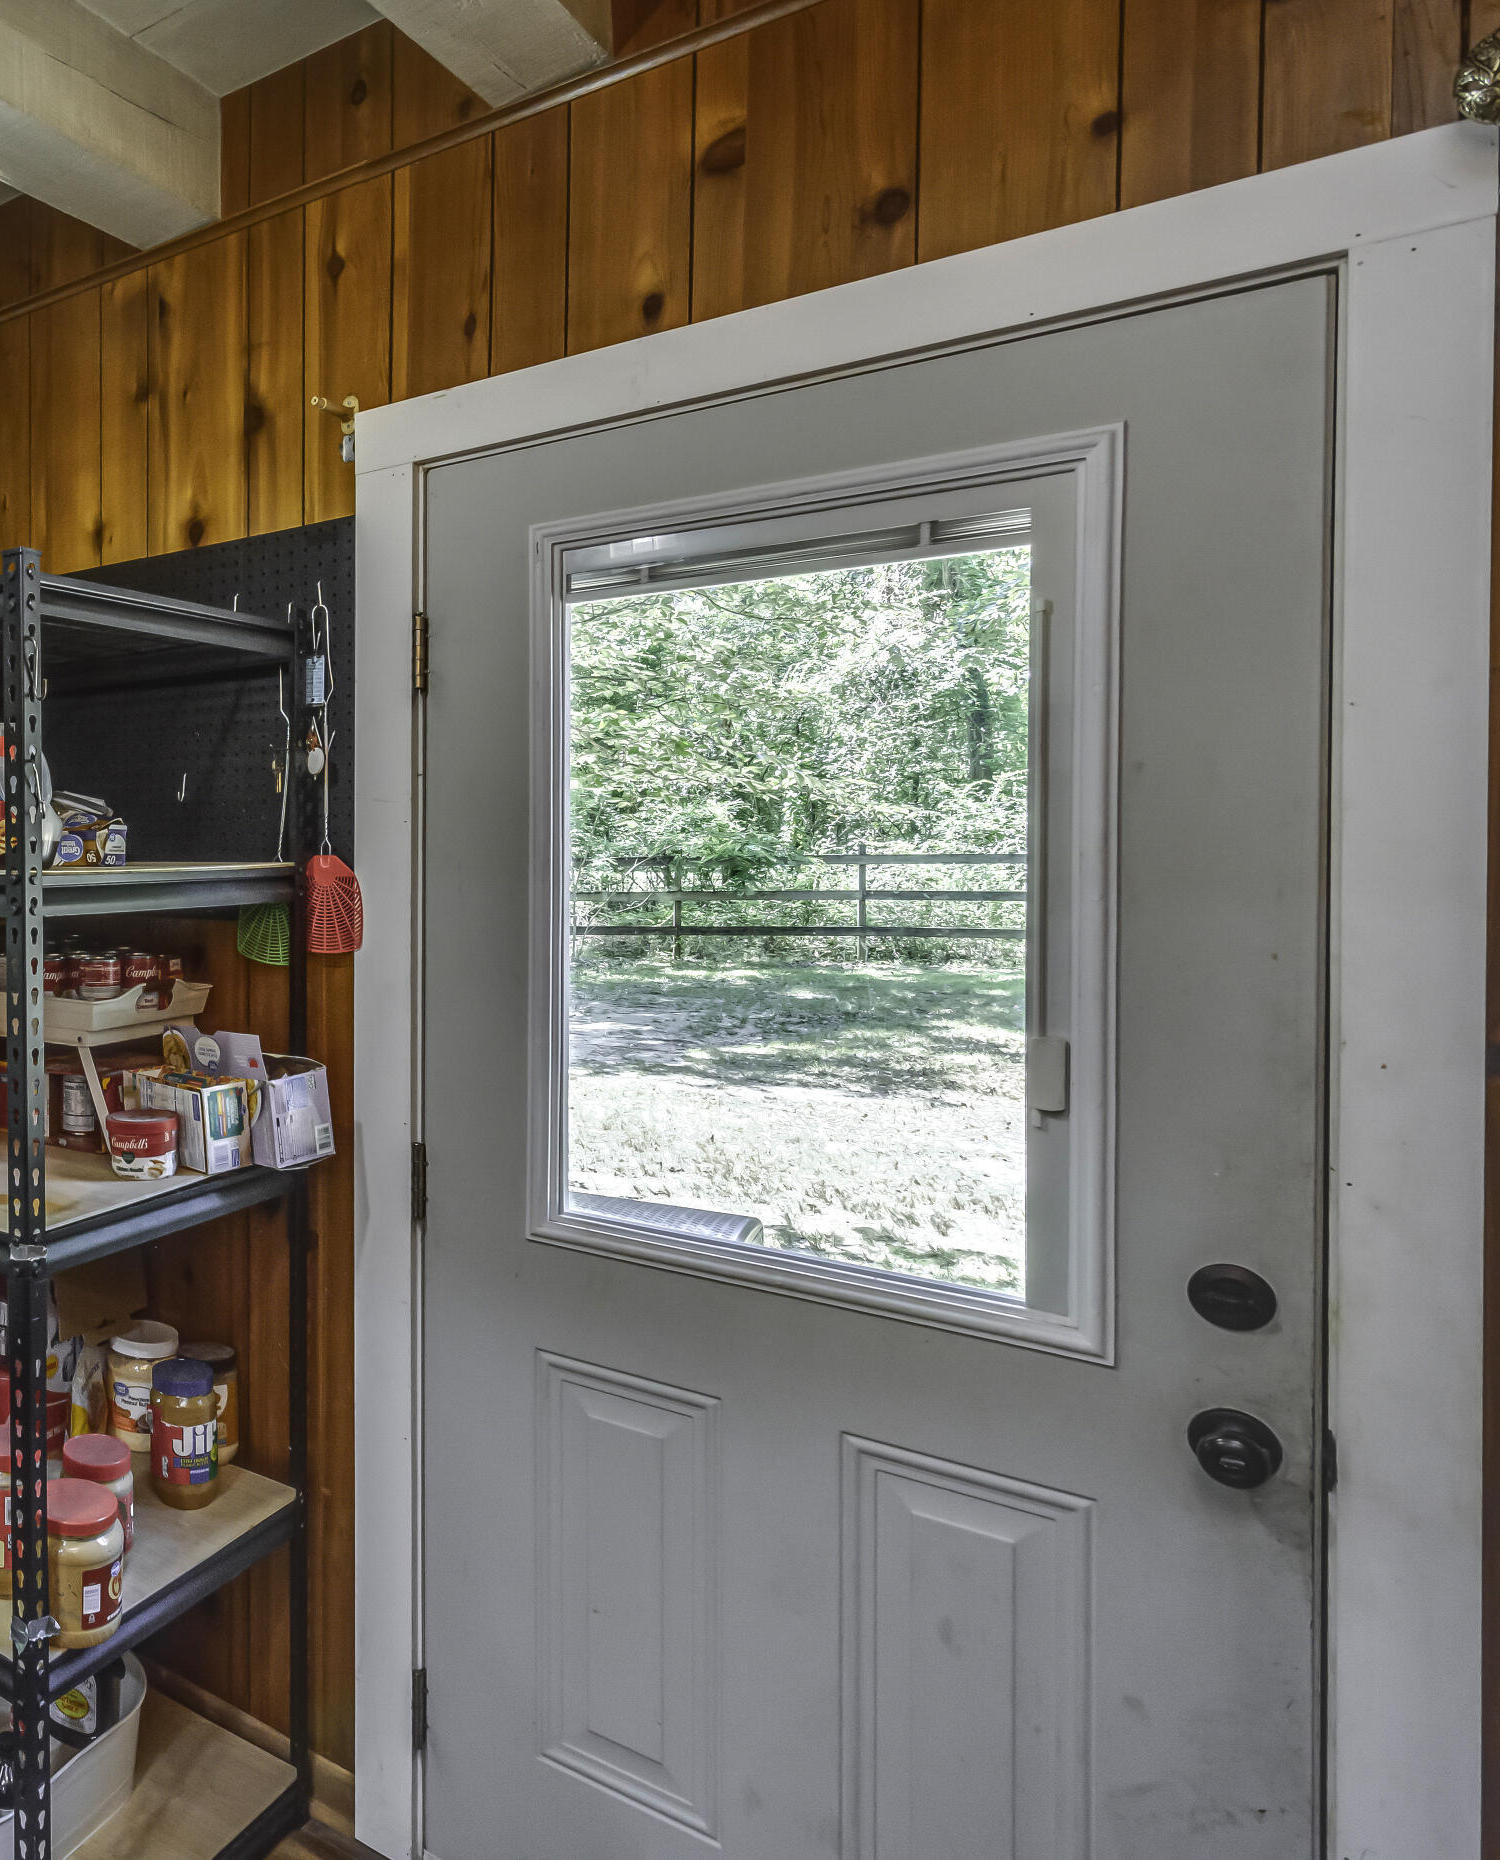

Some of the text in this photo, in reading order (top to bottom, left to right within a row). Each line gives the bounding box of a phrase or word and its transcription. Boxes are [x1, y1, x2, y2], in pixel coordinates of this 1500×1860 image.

[104, 855, 116, 865] 50
[111, 1135, 148, 1150] Campbell's
[171, 1419, 217, 1457] Jif
